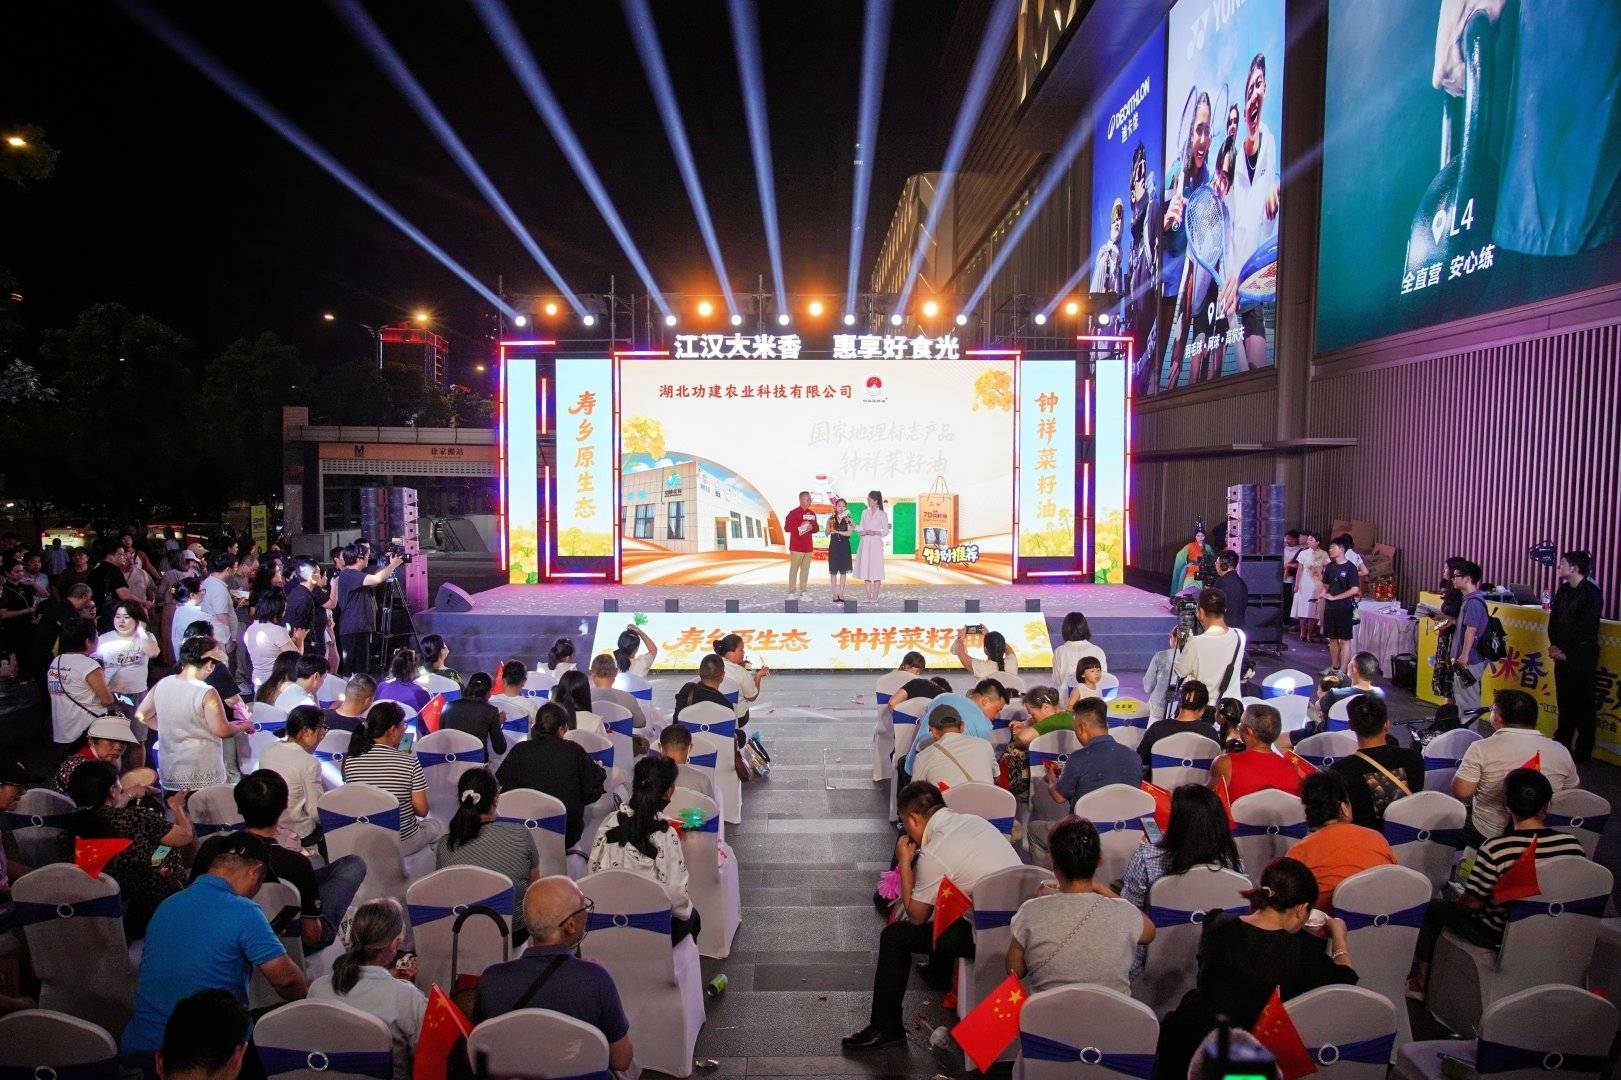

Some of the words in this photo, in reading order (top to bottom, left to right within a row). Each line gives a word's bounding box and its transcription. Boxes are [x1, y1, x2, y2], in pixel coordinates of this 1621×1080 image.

[1116, 76, 1150, 129] DECATHLON
[1450, 198, 1474, 237] L4
[1401, 262, 1443, 295] 全直营
[1448, 243, 1495, 281] 安心练
[673, 333, 802, 360] 江汉大米香
[832, 334, 960, 360] 惠享好食光
[659, 384, 853, 399] 湖北功建农业科技有限公司
[808, 420, 955, 447] 国家地理标志产品
[568, 390, 597, 519] 寿乡原生态
[840, 449, 949, 481] 钟祥菜籽油
[1034, 391, 1059, 519] 钟祥菜籽油
[922, 544, 980, 566] 特别推荐
